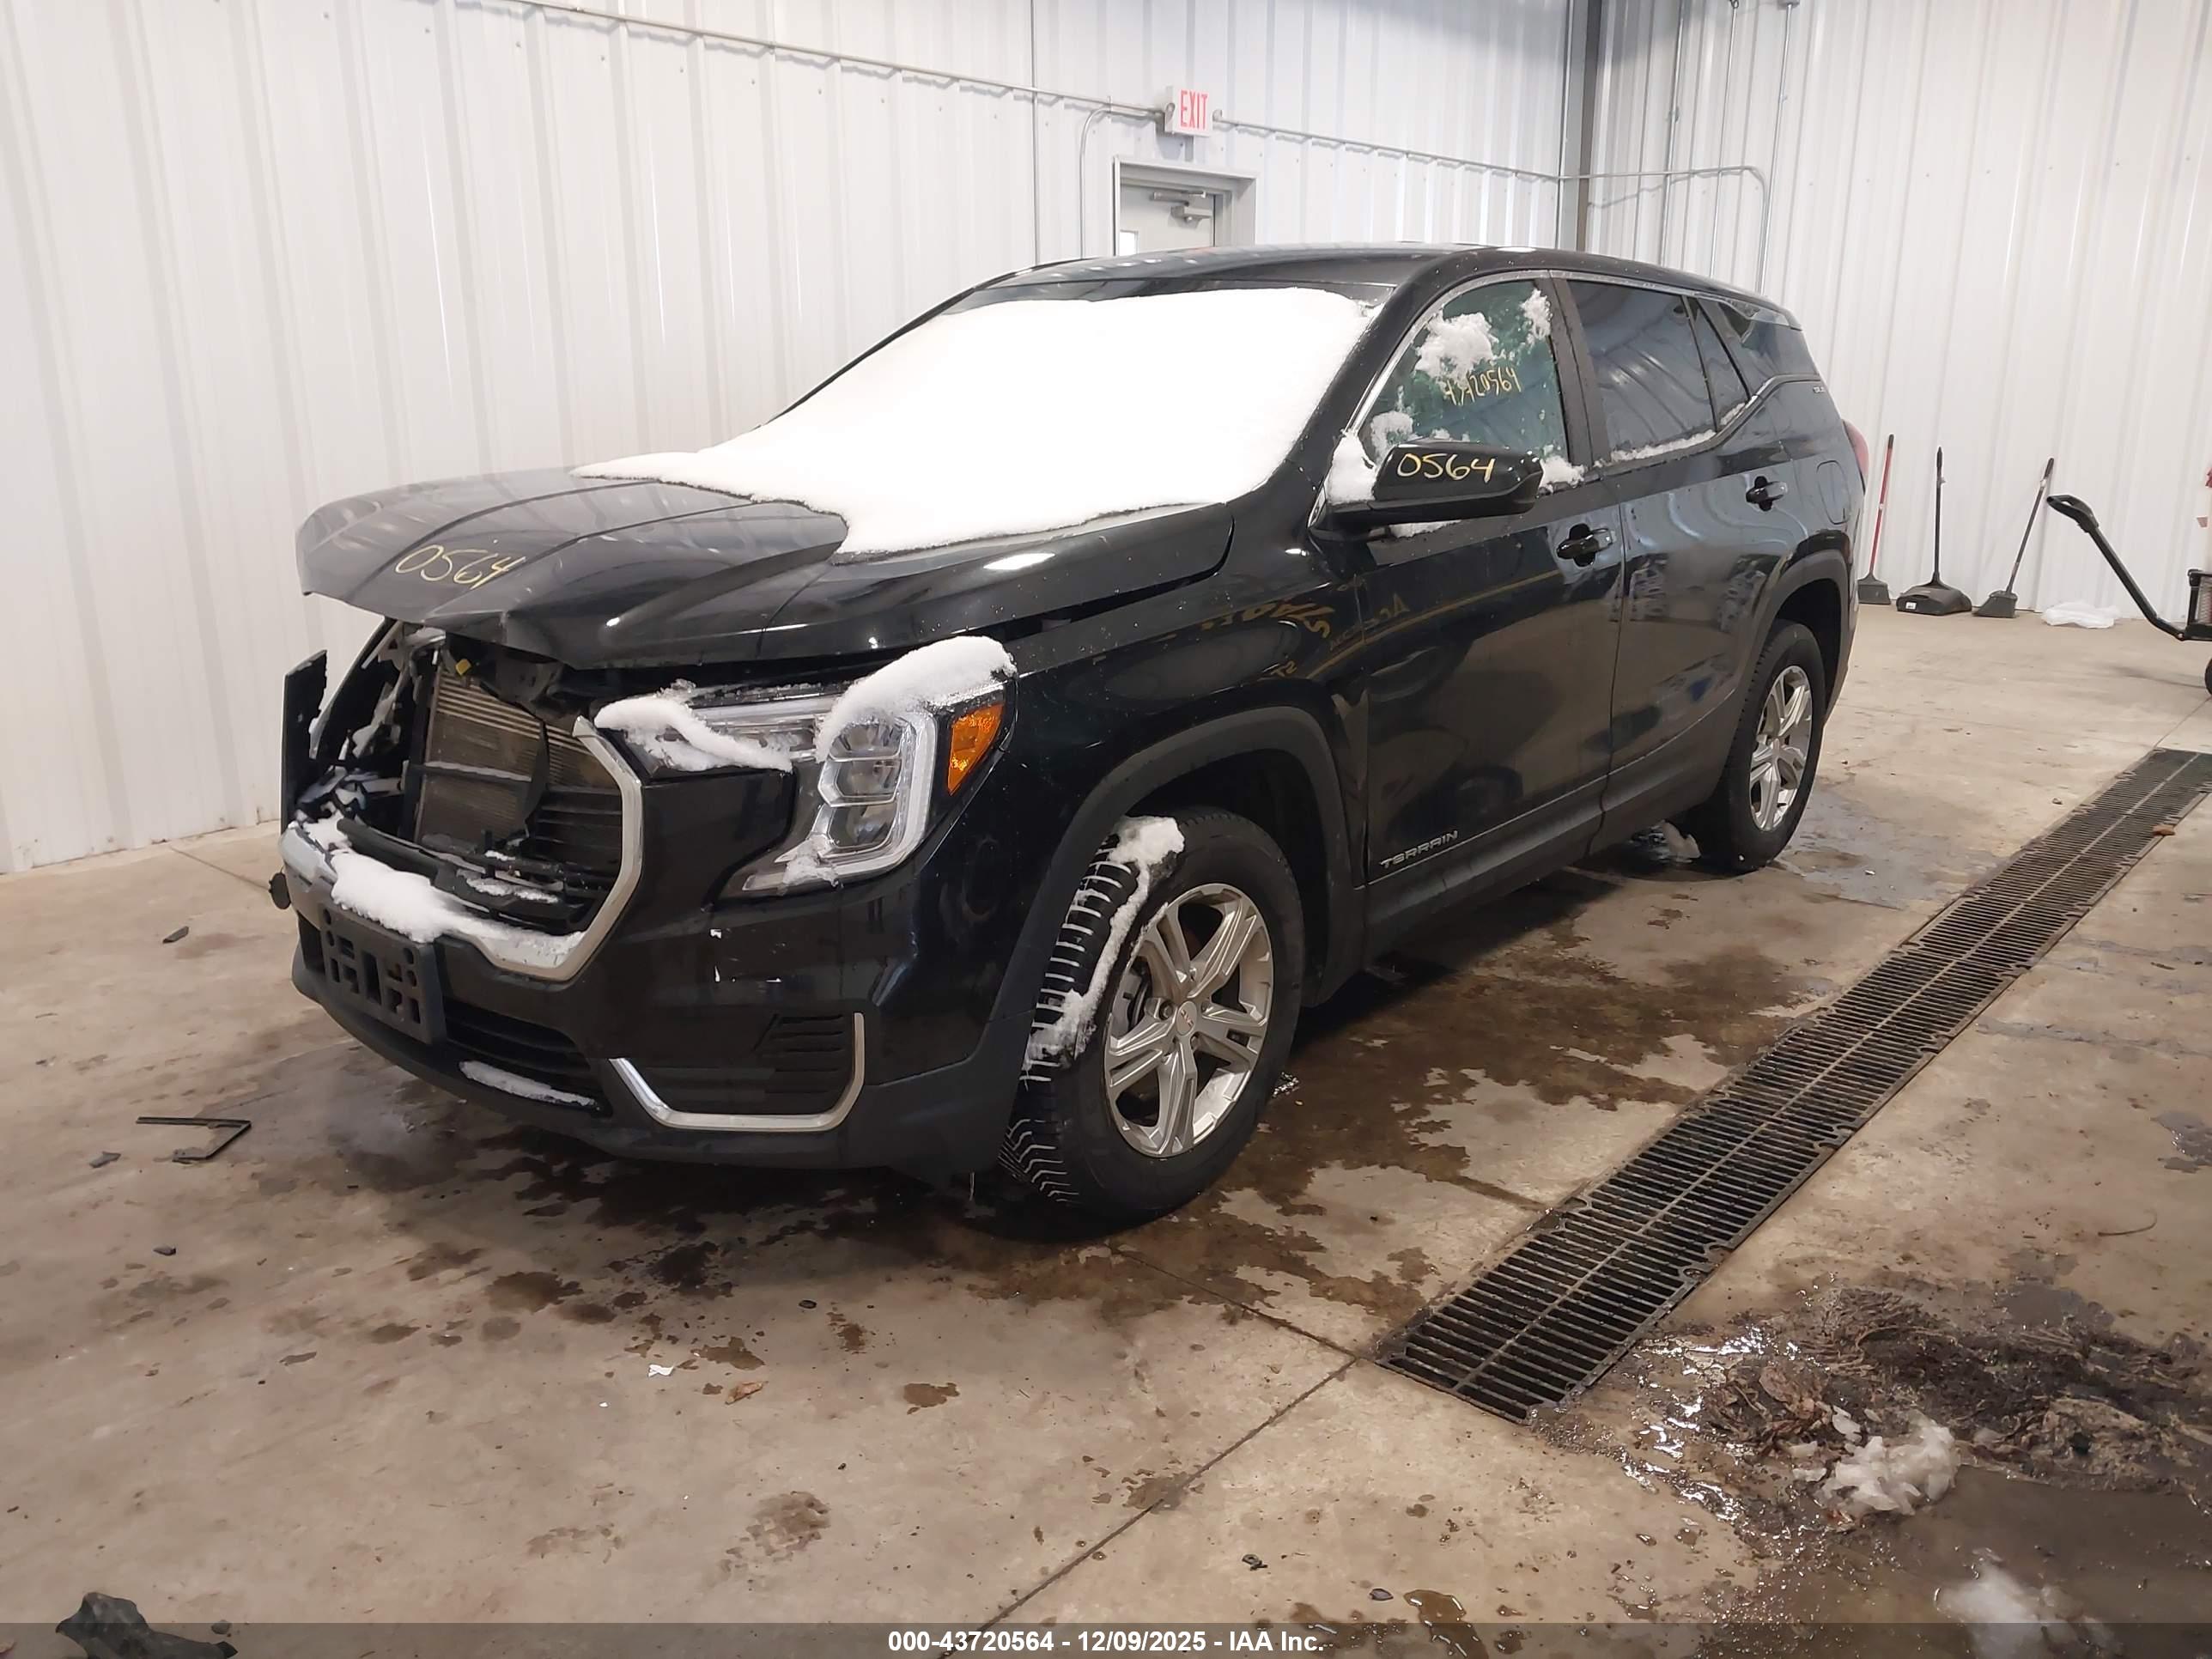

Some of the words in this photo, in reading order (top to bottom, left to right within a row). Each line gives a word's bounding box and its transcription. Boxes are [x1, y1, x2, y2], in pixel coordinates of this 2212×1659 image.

[1181, 90, 1208, 130] EXIT
[1396, 453, 1496, 483] 0564
[395, 544, 526, 590] 0564
[1379, 830, 1458, 868] TERRAIN
